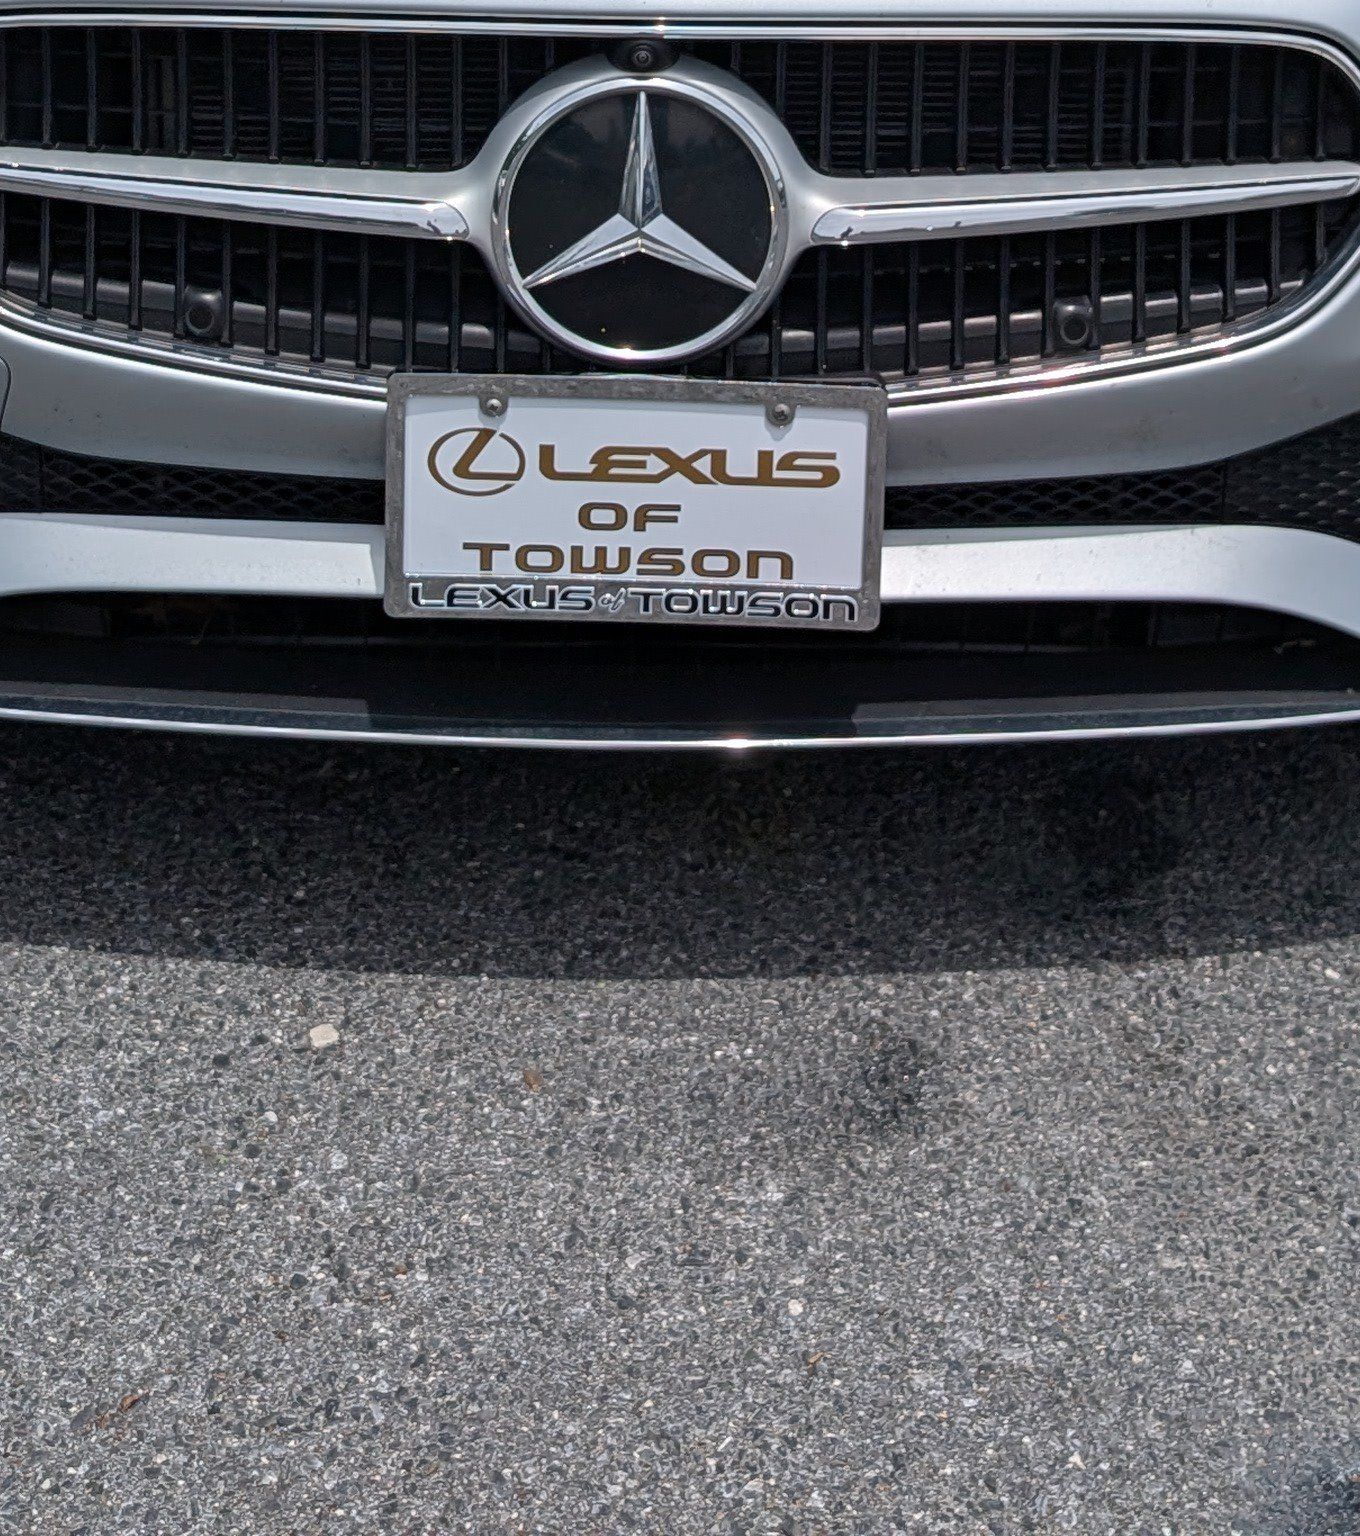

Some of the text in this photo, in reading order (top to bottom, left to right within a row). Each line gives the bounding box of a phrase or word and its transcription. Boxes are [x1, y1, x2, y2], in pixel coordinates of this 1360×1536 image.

[539, 443, 841, 489] LEXUS
[577, 500, 682, 533] OF
[462, 541, 794, 580] TOWSON
[408, 582, 597, 613] LEXUS
[625, 586, 859, 624] TOWSON
